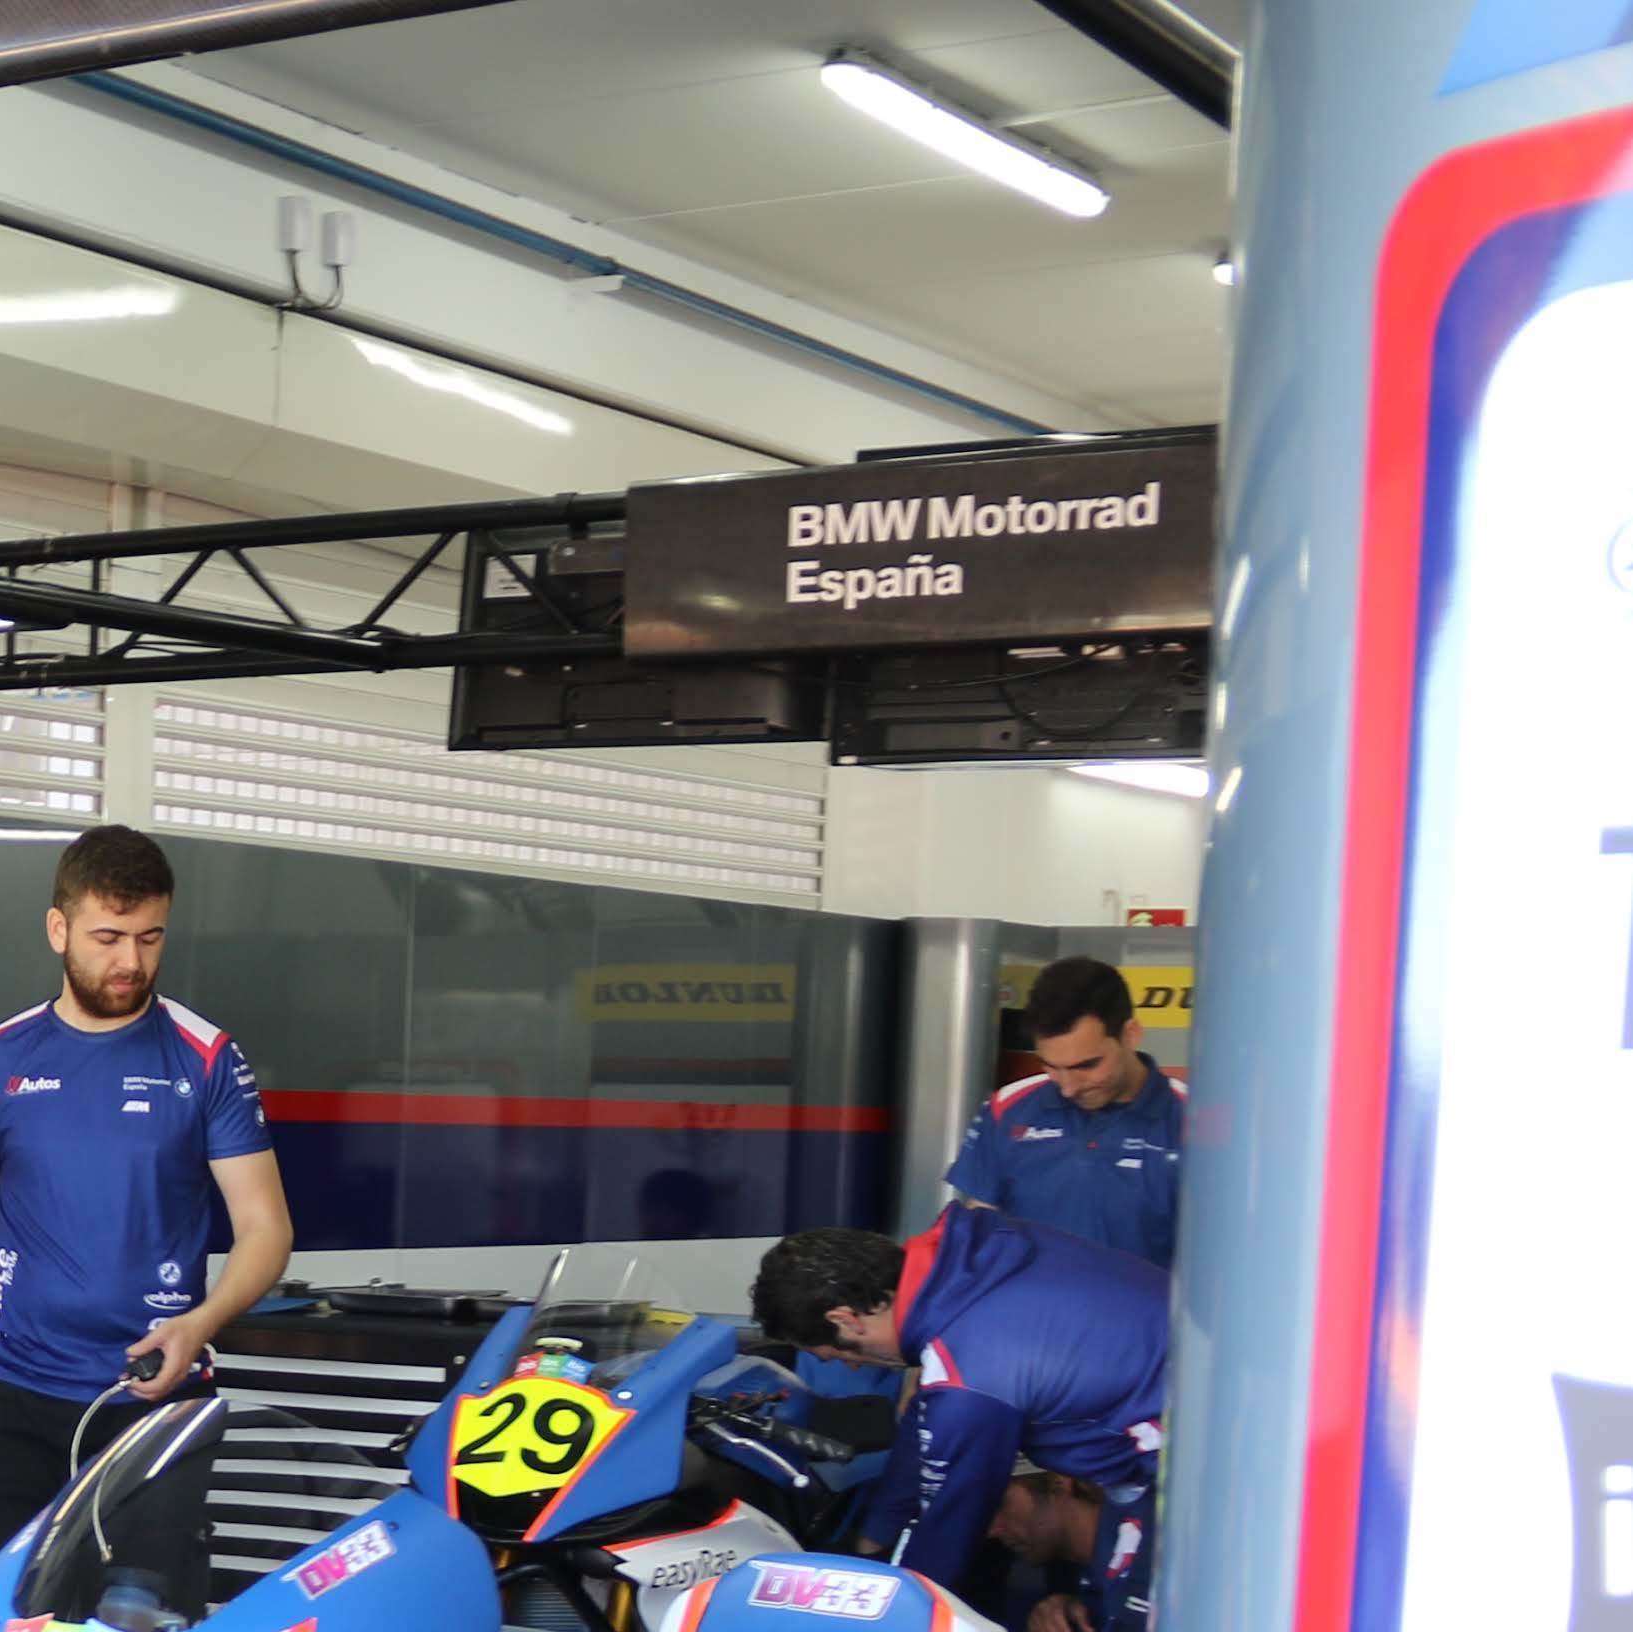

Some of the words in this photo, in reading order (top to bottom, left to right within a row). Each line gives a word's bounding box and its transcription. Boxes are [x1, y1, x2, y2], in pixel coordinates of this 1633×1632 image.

[787, 499, 921, 548] BMW
[927, 482, 1162, 539] Motorrad
[787, 554, 963, 608] España
[457, 1392, 595, 1475] 29
